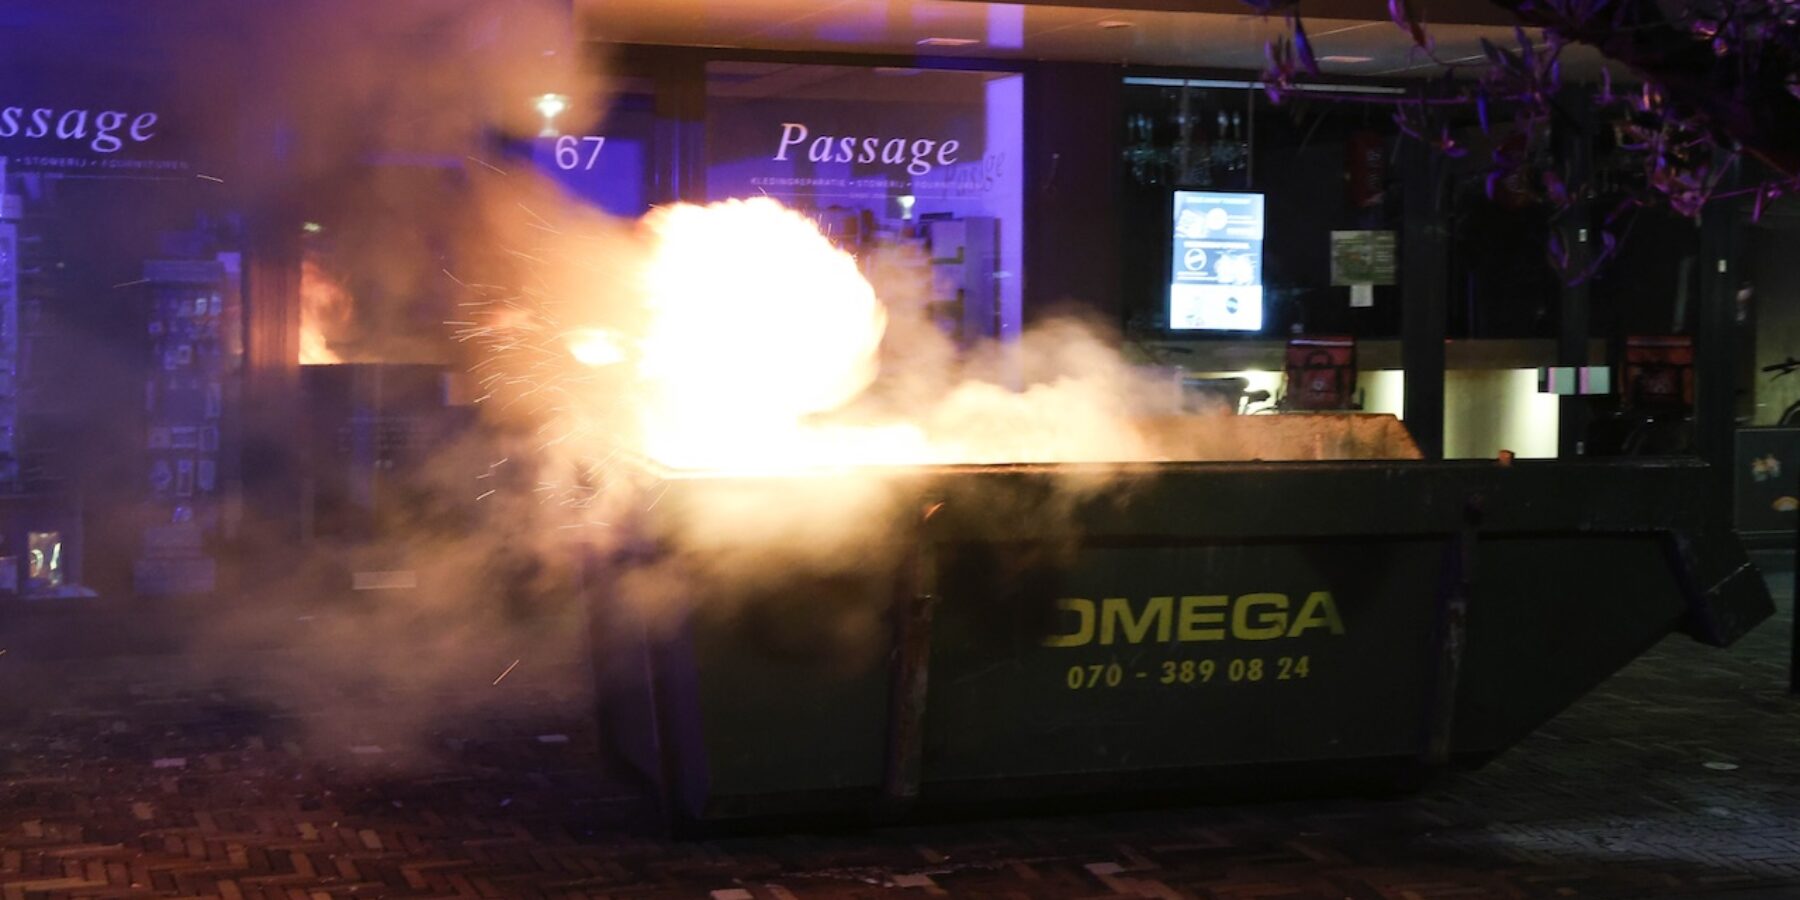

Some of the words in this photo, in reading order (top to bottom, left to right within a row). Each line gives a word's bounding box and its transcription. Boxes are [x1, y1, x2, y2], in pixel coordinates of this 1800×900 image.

[0, 106, 158, 152] ssage
[773, 122, 960, 175] Passage
[555, 135, 605, 170] 67
[1067, 664, 1123, 689] 070
[1160, 659, 1216, 684] 389
[1228, 658, 1264, 682] 08
[1277, 655, 1311, 681] 24
